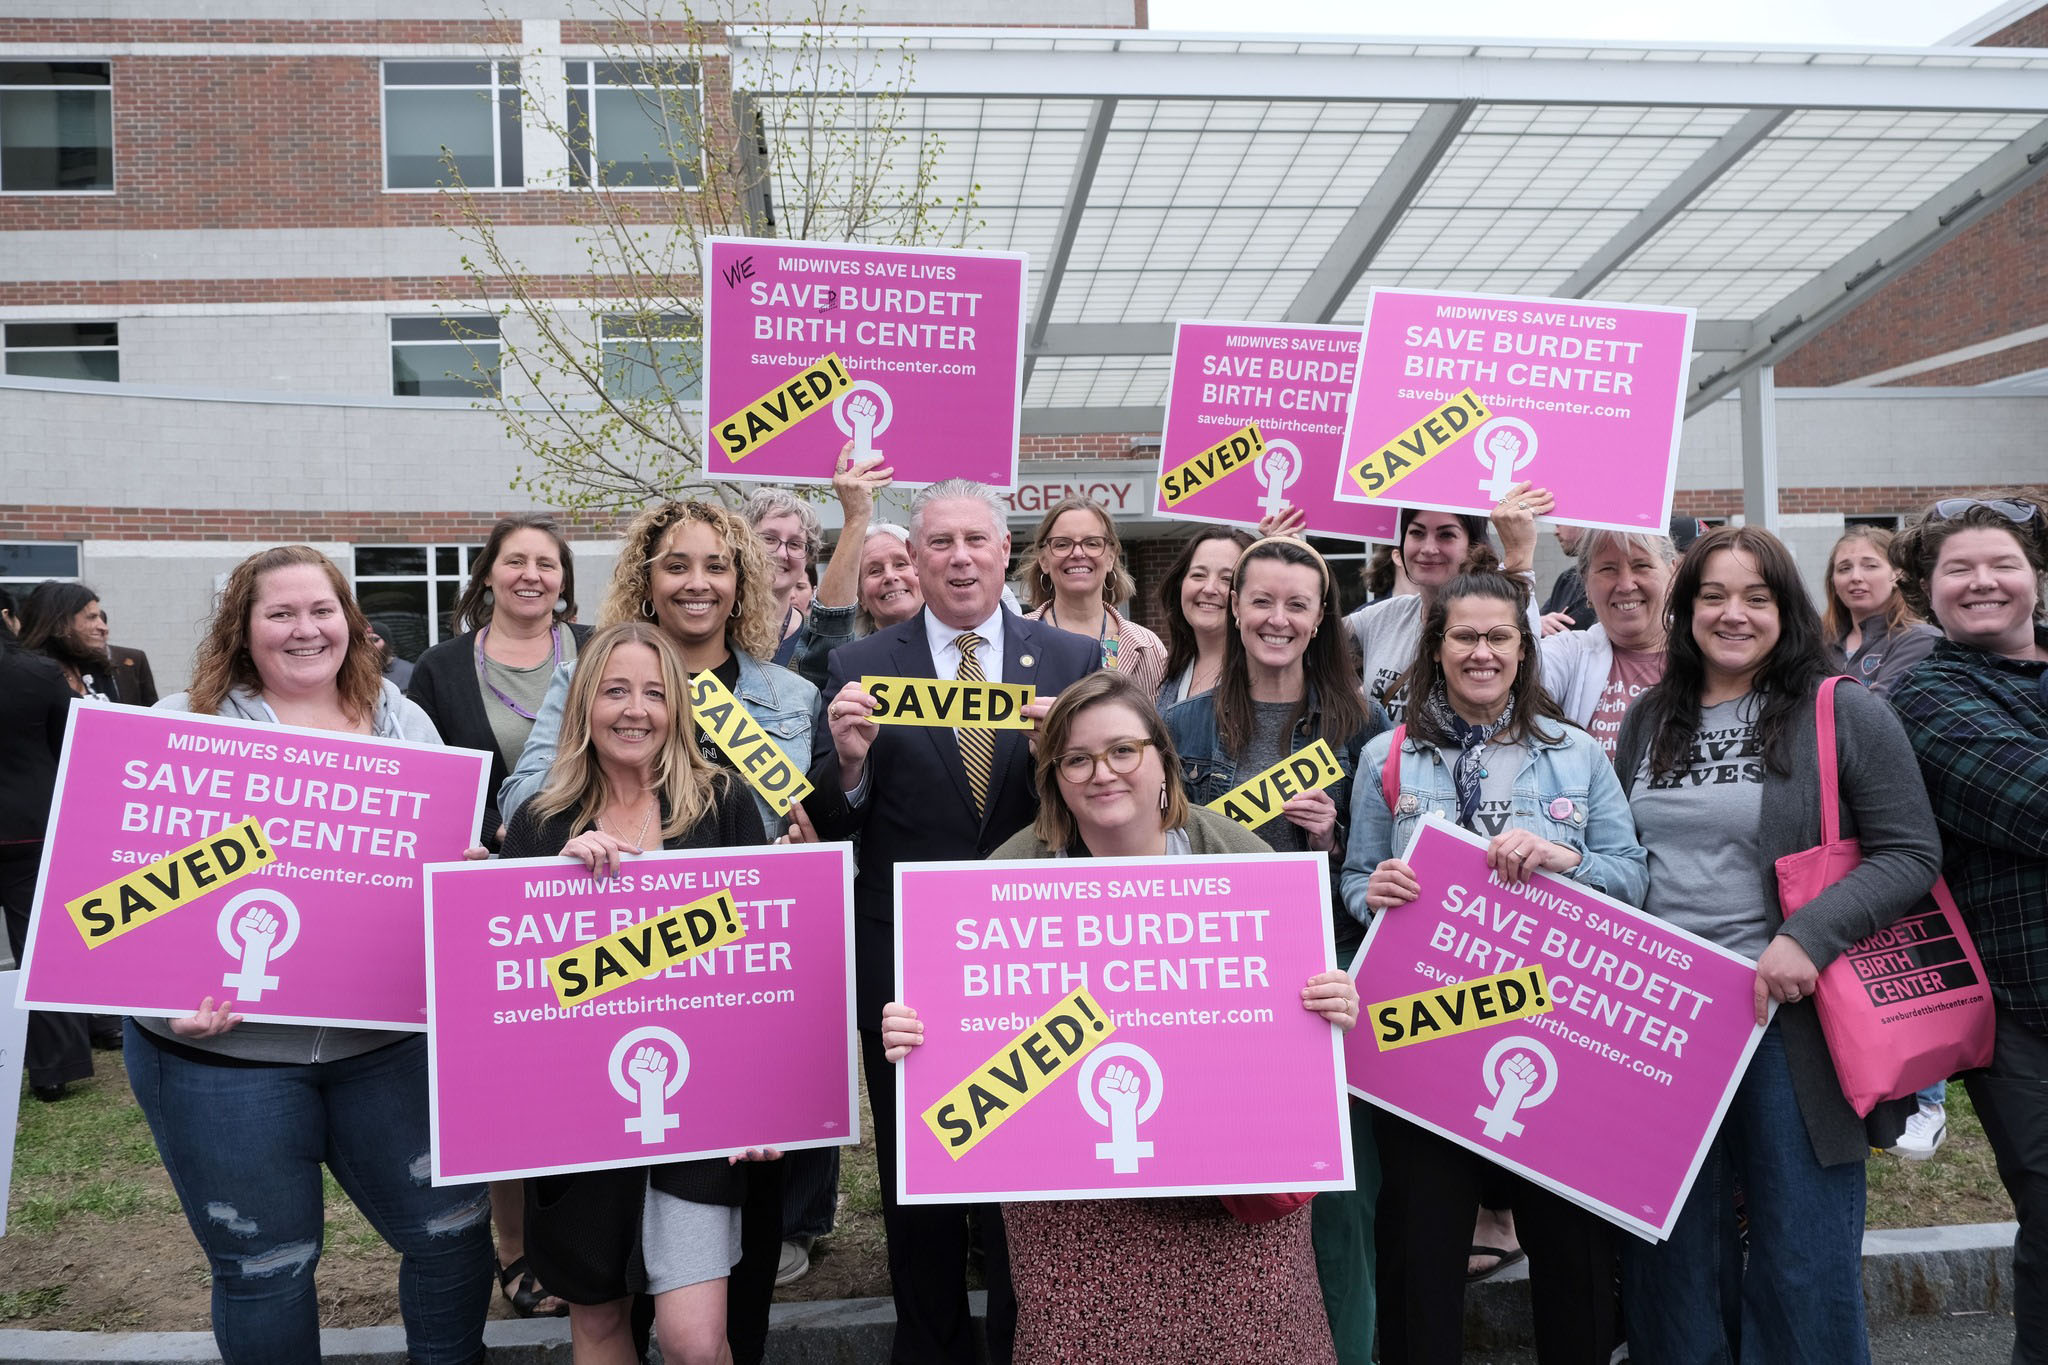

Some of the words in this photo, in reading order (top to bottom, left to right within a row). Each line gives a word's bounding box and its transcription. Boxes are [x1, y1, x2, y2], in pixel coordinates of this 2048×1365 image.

[722, 256, 756, 289] WE
[778, 257, 860, 276] MIDWIVES
[864, 263, 907, 278] SAVE
[911, 265, 956, 280] LIVES
[840, 286, 982, 316] BURDETT
[1436, 305, 1518, 323] MIDWIVES
[1522, 310, 1566, 327] SAVE
[1569, 315, 1617, 330] LIVES
[754, 316, 846, 344] BIRTH
[856, 320, 976, 350] CENTER
[1226, 335, 1288, 350] MIDWIVES
[1291, 338, 1326, 352] SAVE
[1404, 325, 1486, 352] SAVE
[1493, 332, 1643, 364] BURDETT
[751, 352, 976, 376] saveburtbirthcenter.com
[1203, 354, 1264, 378] SAVE
[1268, 358, 1357, 384] BURDE
[1404, 354, 1498, 383] BIRTH
[1506, 362, 1634, 396] CENTER
[722, 359, 848, 454] SAVED!
[1202, 383, 1272, 408] BIRTH
[1279, 388, 1352, 413] CENT
[1397, 387, 1631, 419] savebuttbirthcenter.com
[1360, 393, 1484, 490] SAVED!
[1164, 427, 1262, 501] SAVED!
[868, 683, 1030, 724] SAVED!
[167, 732, 278, 762] MIDWIVES
[283, 746, 338, 769] SAVE
[343, 755, 401, 776] LIVES
[691, 680, 806, 809] SAVED!
[121, 760, 236, 800] SAVE
[244, 772, 431, 820] BURDETT
[262, 817, 419, 859] CENTER
[81, 824, 268, 938] SAVED!
[524, 876, 634, 899] MIDWIVES
[640, 872, 698, 892] SAVE
[702, 869, 760, 888] LIVES
[991, 882, 1102, 902] MIDWIVES
[1107, 879, 1166, 899] SAVE
[1170, 878, 1232, 897] LIVES
[488, 910, 597, 947] SAVE
[558, 896, 737, 998] SAVED!
[955, 916, 1064, 951] SAVE
[1077, 909, 1270, 947] BURDETT
[1585, 914, 1638, 946] SAVE
[1638, 935, 1694, 971] LIVES
[640, 942, 792, 980] ENTER
[1441, 884, 1540, 946] SAVE
[1540, 927, 1714, 1022] BURDETT
[1854, 950, 1915, 979] BIRTH
[963, 961, 1088, 997] BIRTH
[1103, 956, 1270, 994] CENTER
[1430, 921, 1525, 974] BIRT
[1548, 975, 1690, 1059] CENTER
[1869, 971, 1948, 1004] CENTER
[492, 988, 795, 1025] saveburdettbirthcenter.com
[960, 1008, 1274, 1033] savebuirthcenter.com
[1378, 971, 1546, 1042] SAVED!
[1881, 995, 1984, 1024] saveburdettbirthcenter.com
[936, 996, 1104, 1148] SAVED!
